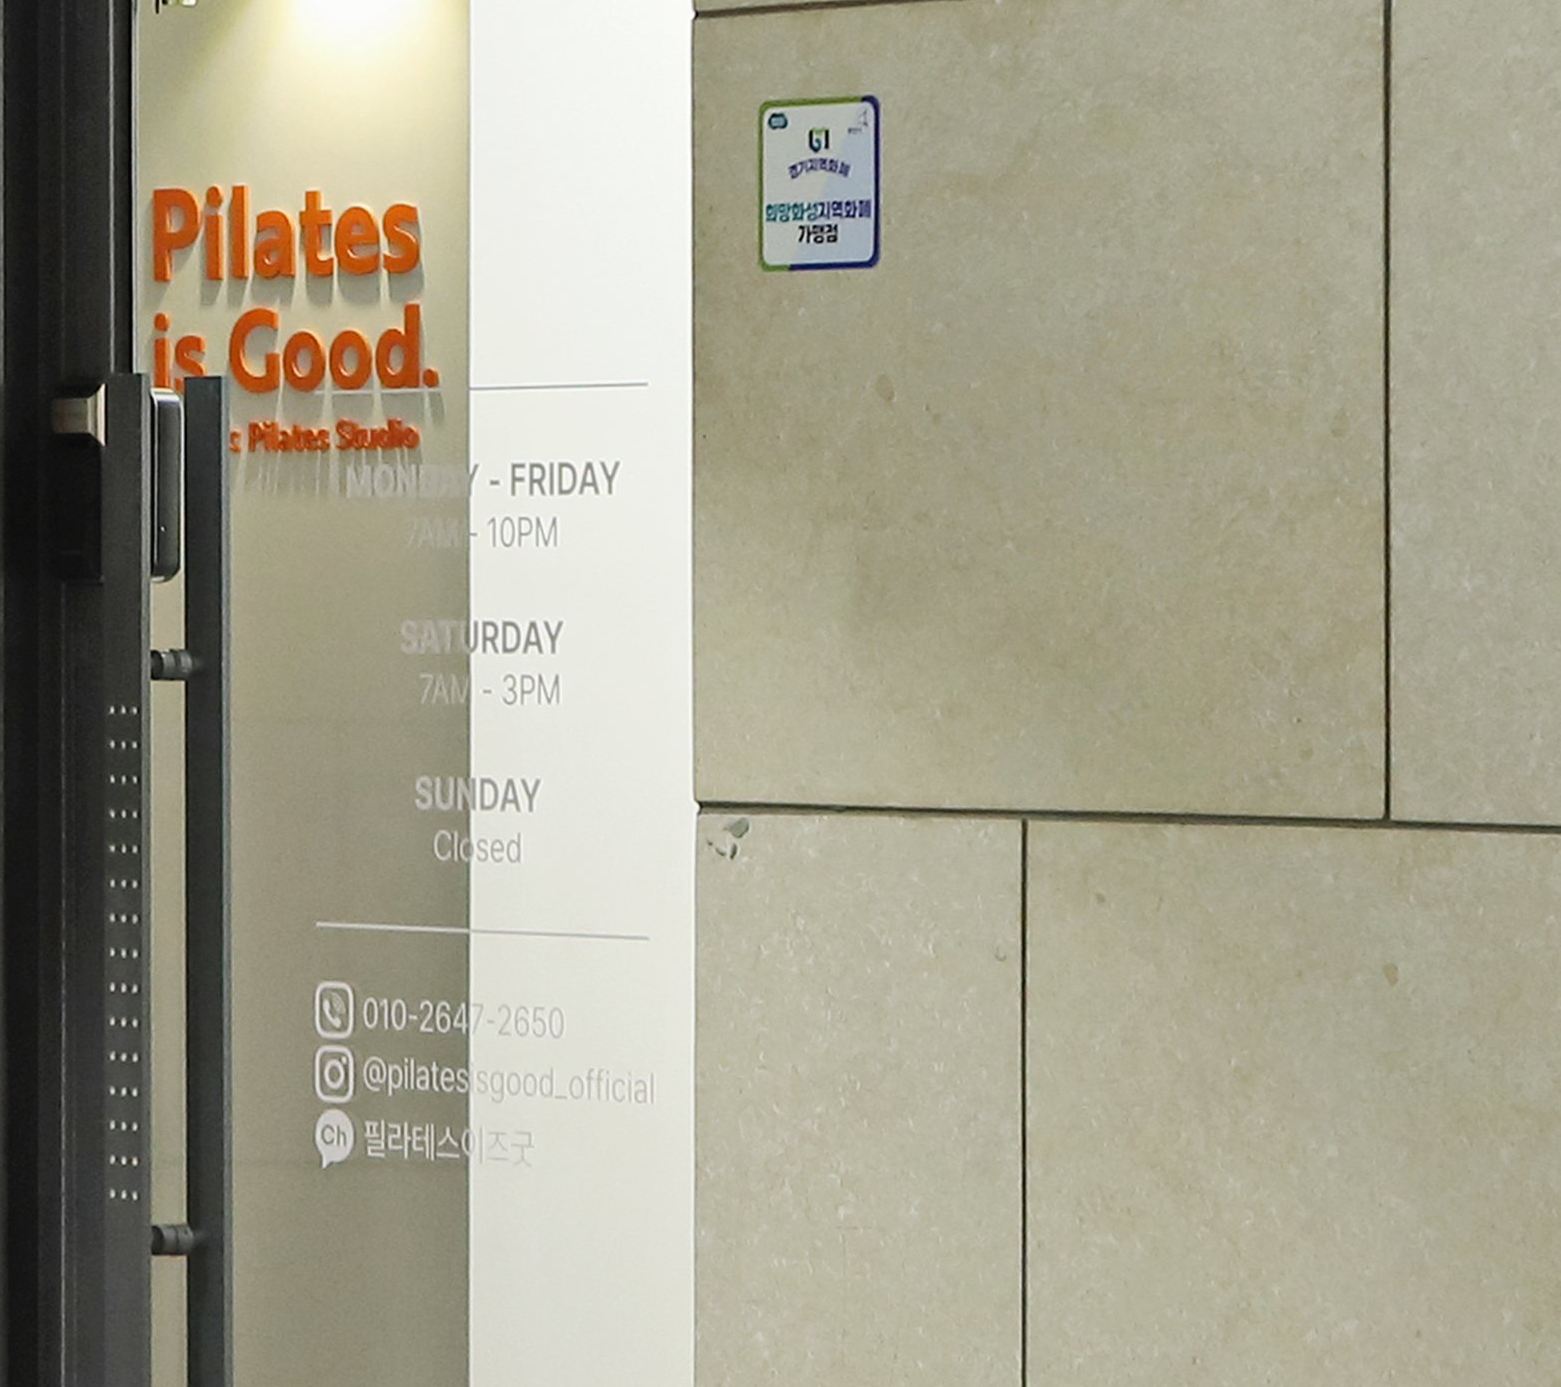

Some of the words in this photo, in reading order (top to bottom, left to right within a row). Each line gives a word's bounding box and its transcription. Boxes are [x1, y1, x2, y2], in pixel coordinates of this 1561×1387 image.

[151, 184, 421, 283] Pilates
[798, 224, 839, 244] 가맹점
[152, 313, 207, 391] is
[228, 303, 440, 394] Good.
[248, 420, 331, 453] Pilates
[335, 418, 421, 451] Studio
[510, 460, 621, 497] FRIDAY
[404, 516, 462, 549] 7AM
[487, 516, 558, 548] 10PM
[400, 619, 564, 655] SATURDAY
[419, 673, 470, 706] 7AM
[502, 673, 561, 706] 3PM
[414, 775, 542, 813] SUNDAY
[433, 829, 522, 864] Closed
[362, 996, 565, 1040] 010-2647-2650
[362, 1055, 657, 1105] @pilatesisgood_official
[363, 1119, 536, 1168] 필라테스이즈굿
